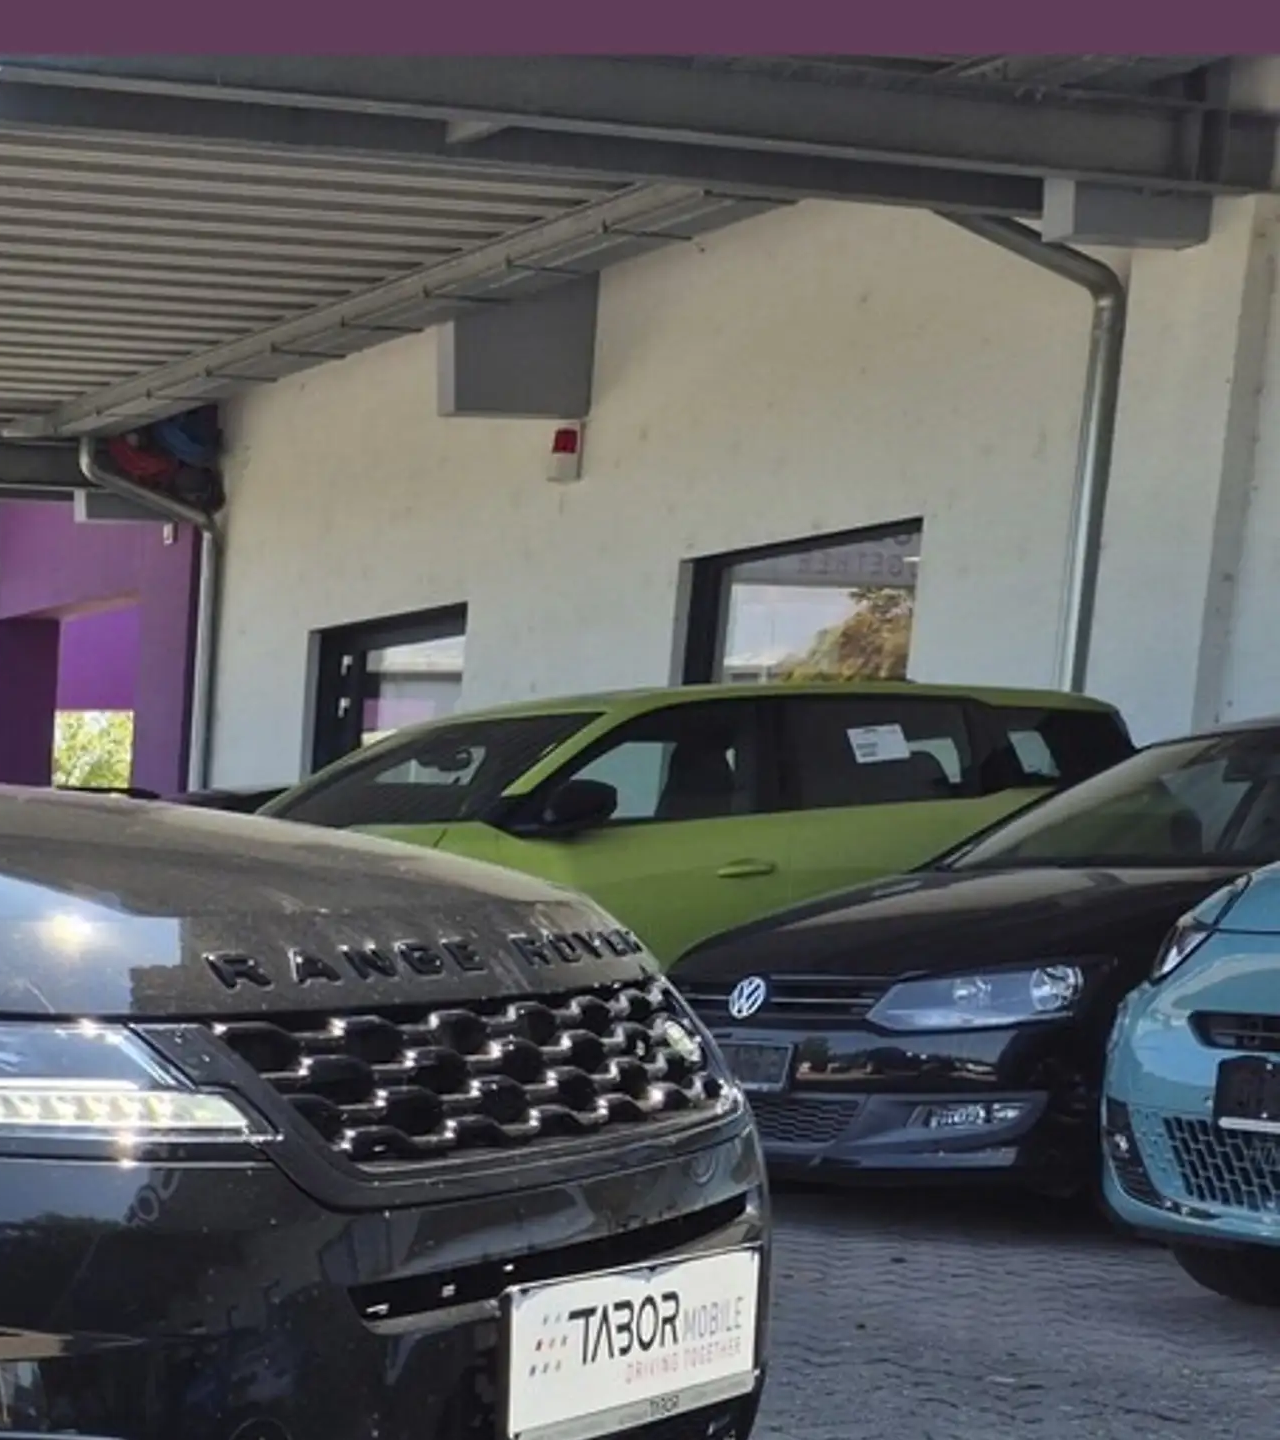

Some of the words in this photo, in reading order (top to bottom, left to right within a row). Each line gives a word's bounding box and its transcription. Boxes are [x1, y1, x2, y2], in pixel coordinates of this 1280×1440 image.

[202, 938, 486, 990] RANGE
[568, 1290, 680, 1366] TABOR
[682, 1296, 744, 1341] MOBILE
